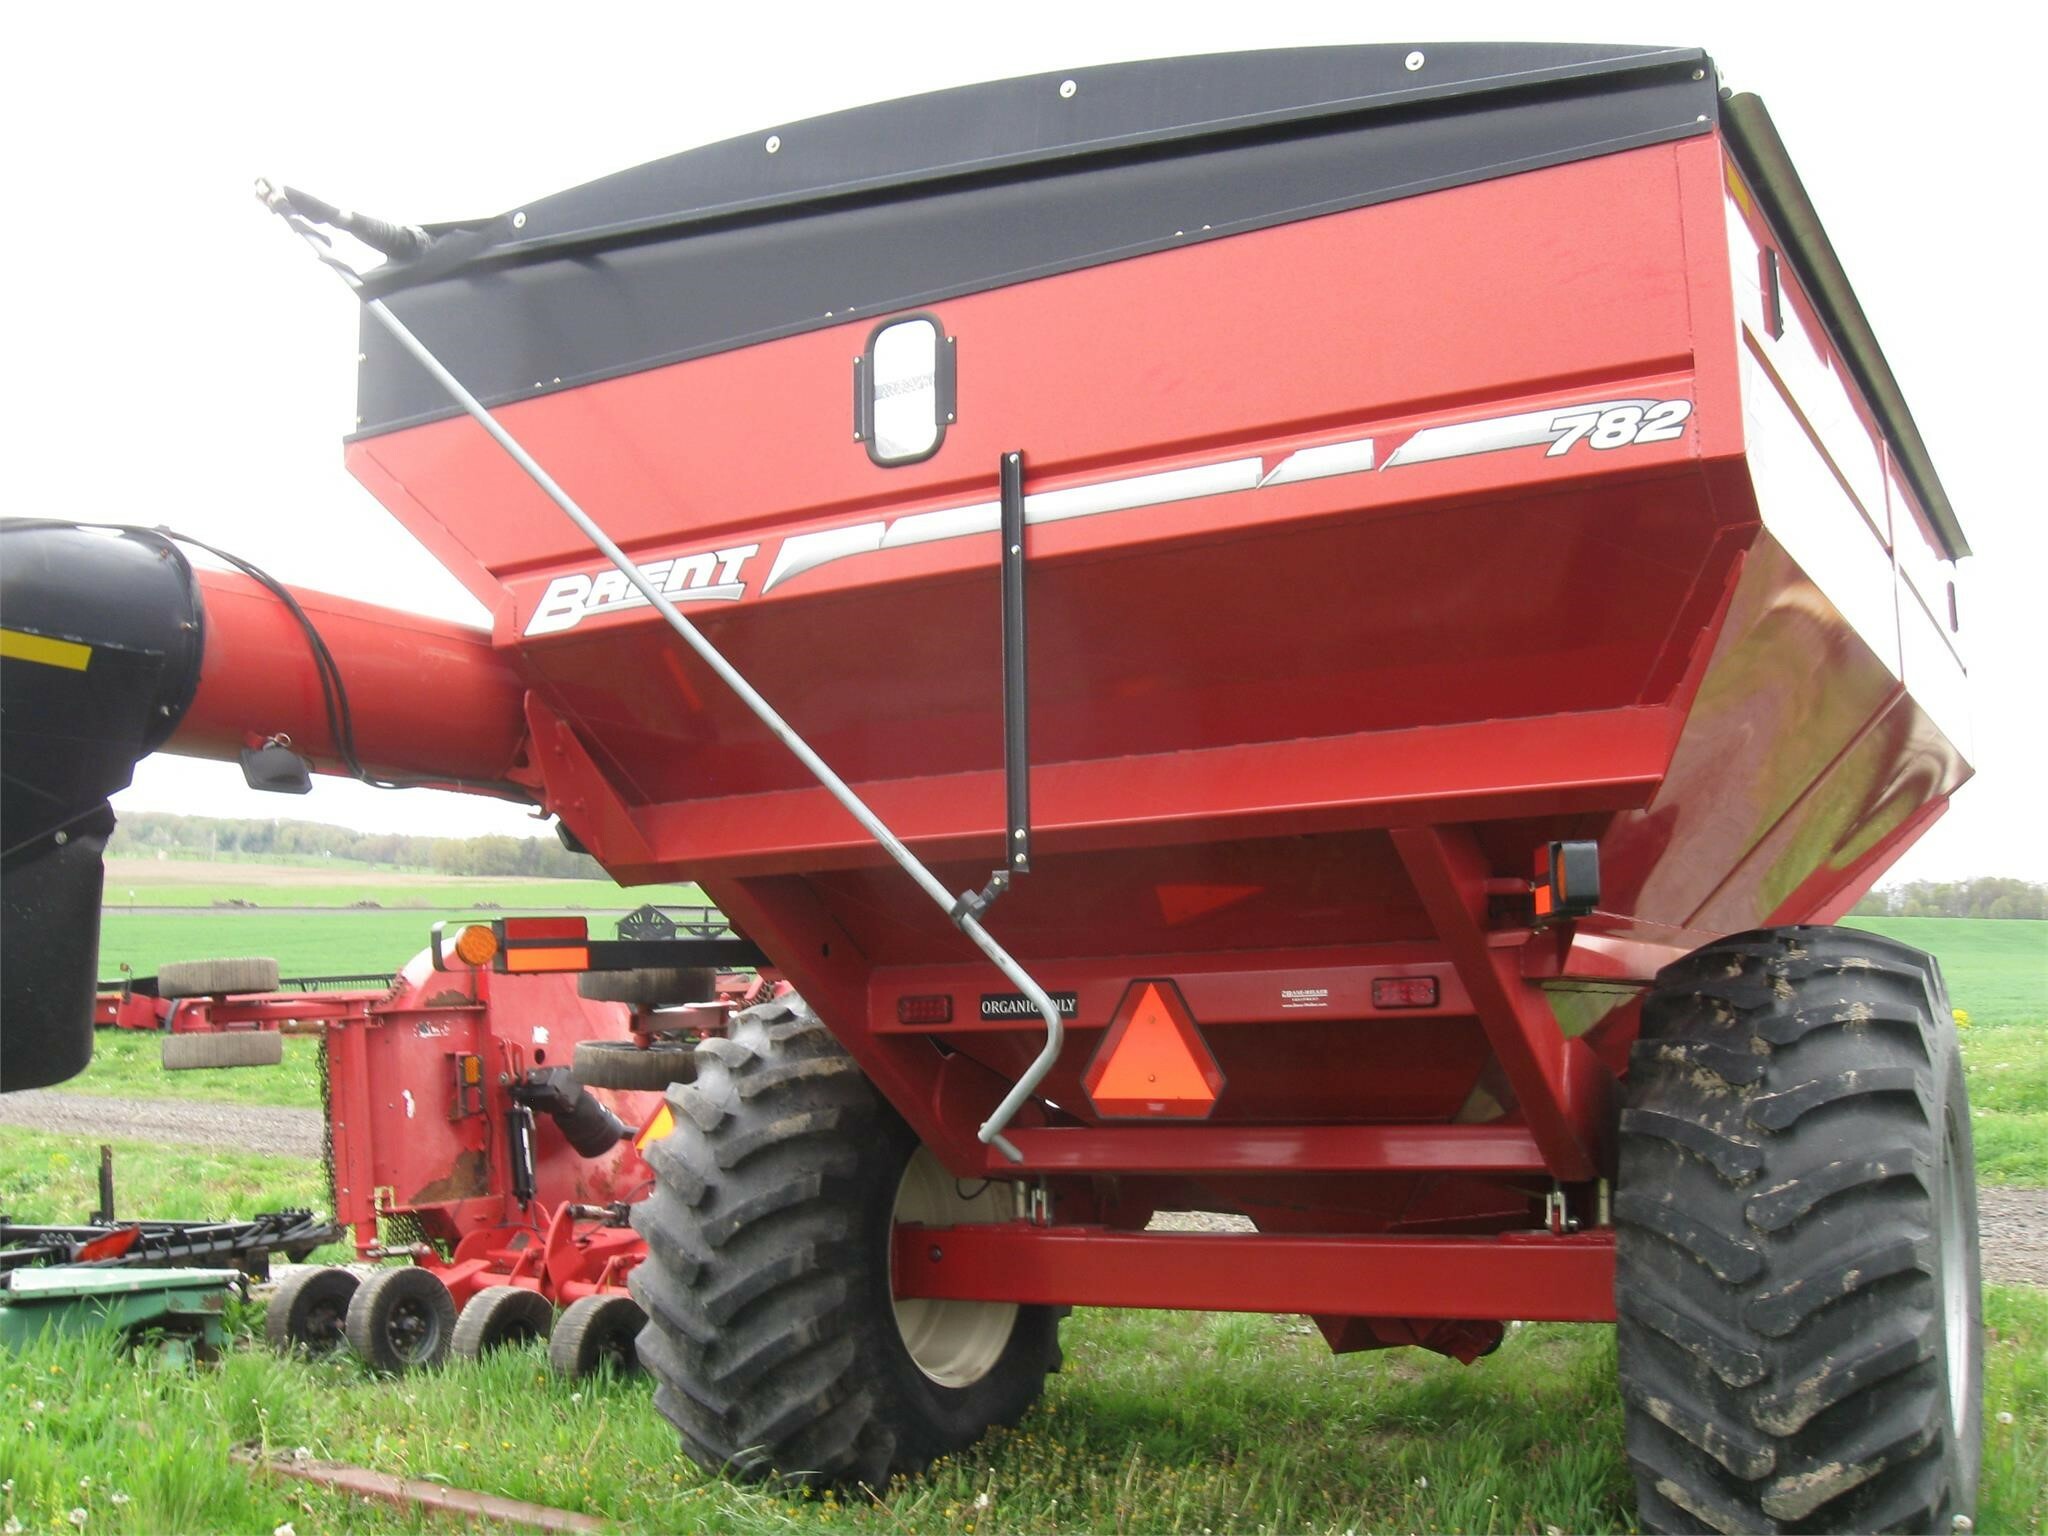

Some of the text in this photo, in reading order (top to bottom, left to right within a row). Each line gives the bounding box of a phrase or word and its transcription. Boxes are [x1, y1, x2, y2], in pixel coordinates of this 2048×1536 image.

[1545, 399, 1693, 458] 782
[981, 999, 1076, 1014] ORGANIC NLY
